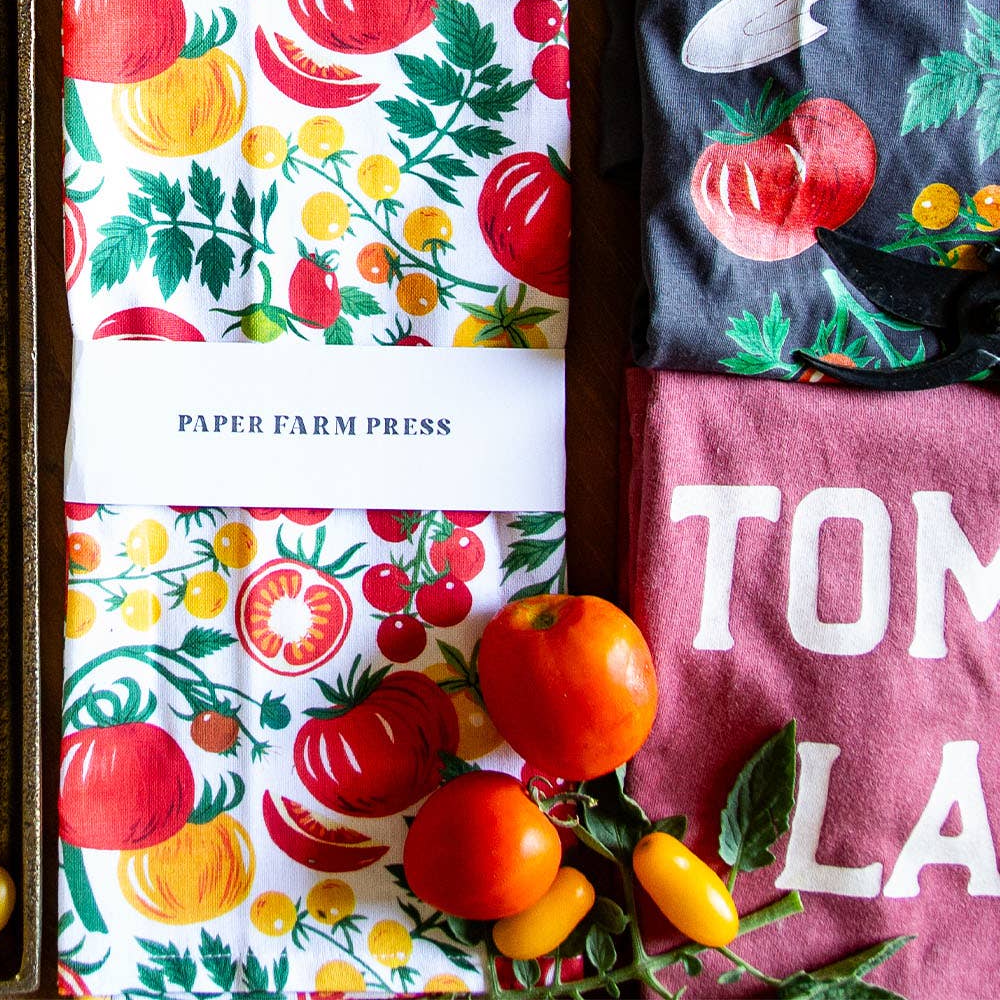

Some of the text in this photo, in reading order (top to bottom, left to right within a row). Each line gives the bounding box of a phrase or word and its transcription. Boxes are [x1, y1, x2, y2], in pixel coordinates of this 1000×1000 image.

[178, 414, 452, 436] PAPER FARM PRESS
[670, 485, 1000, 659] TOM
[774, 740, 1000, 898] LA
